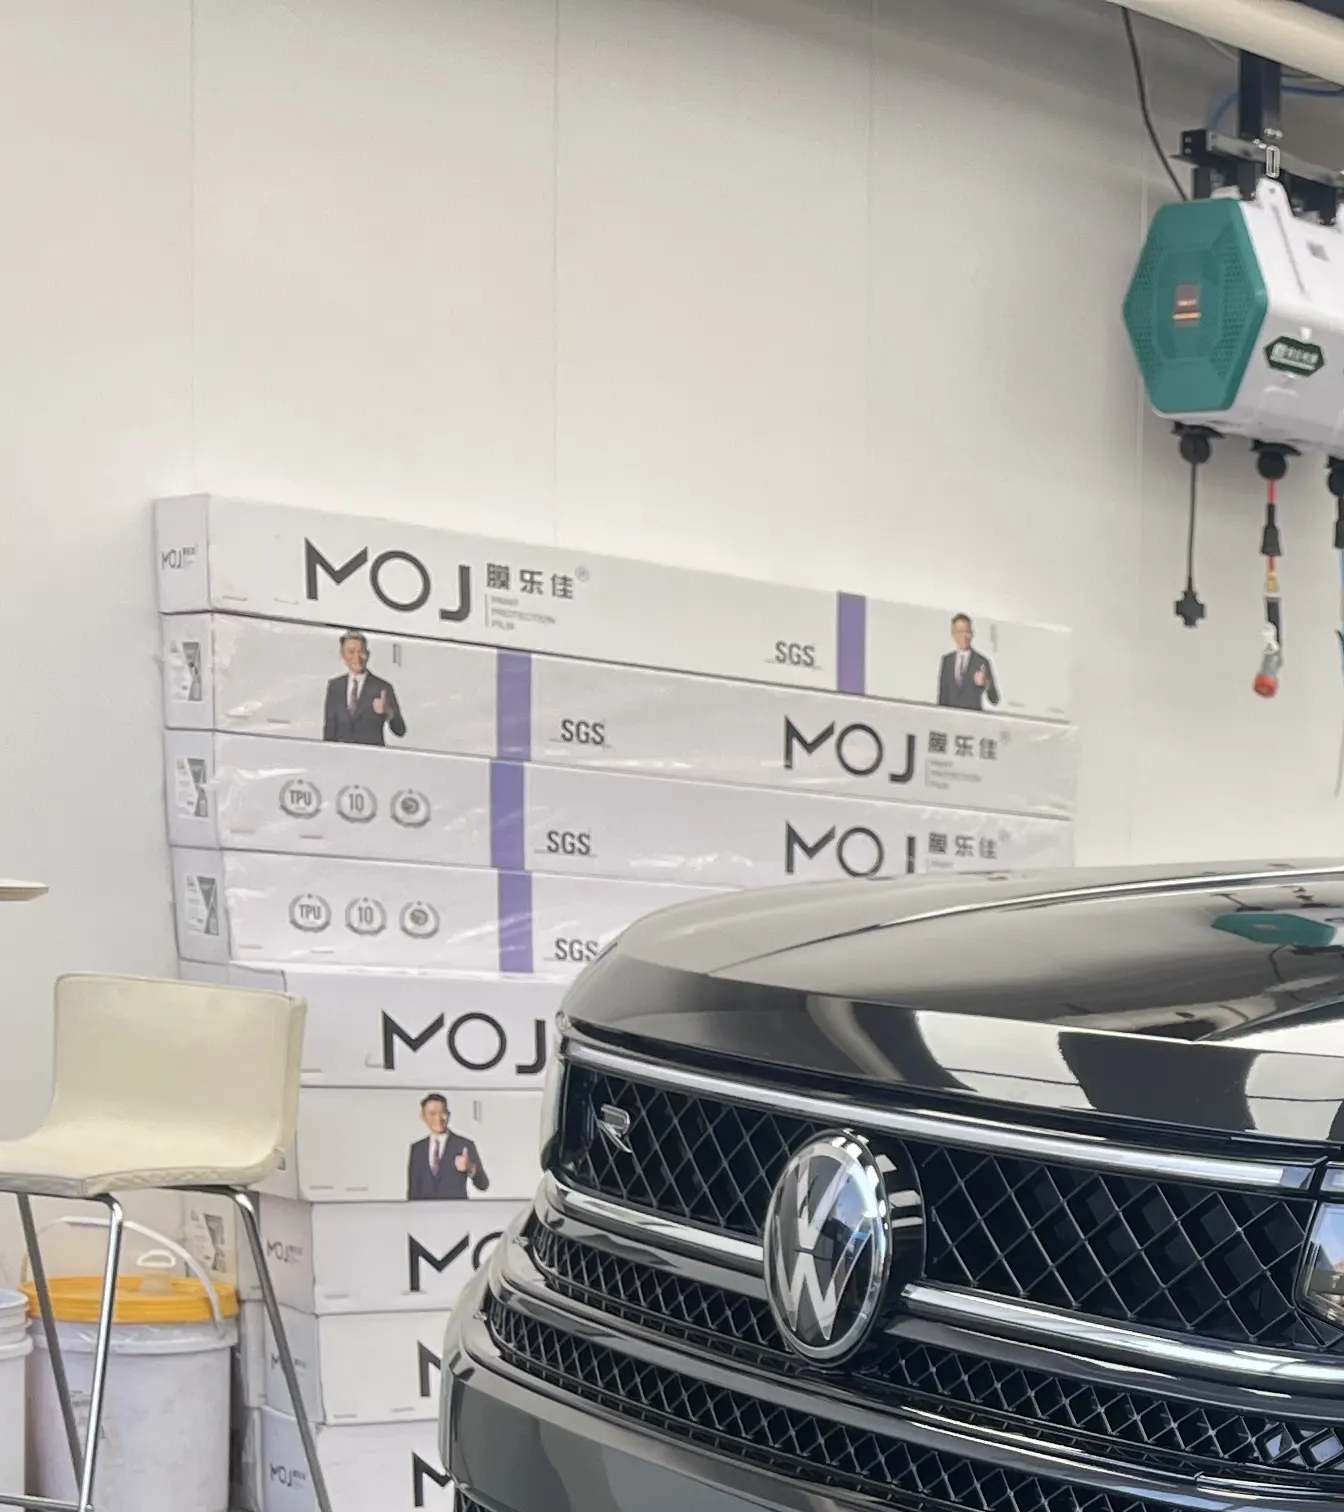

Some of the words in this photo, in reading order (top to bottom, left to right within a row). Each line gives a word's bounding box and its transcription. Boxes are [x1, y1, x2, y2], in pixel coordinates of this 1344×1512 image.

[304, 537, 472, 622] MOJ
[775, 640, 816, 668] SGS
[560, 718, 606, 746] SGS
[784, 714, 916, 784] MOJ
[289, 789, 312, 807] TPU
[348, 793, 365, 813] 10
[546, 830, 591, 856] SGS
[299, 904, 321, 921] TPU
[357, 906, 374, 925] 10
[381, 1010, 547, 1075] MOJ
